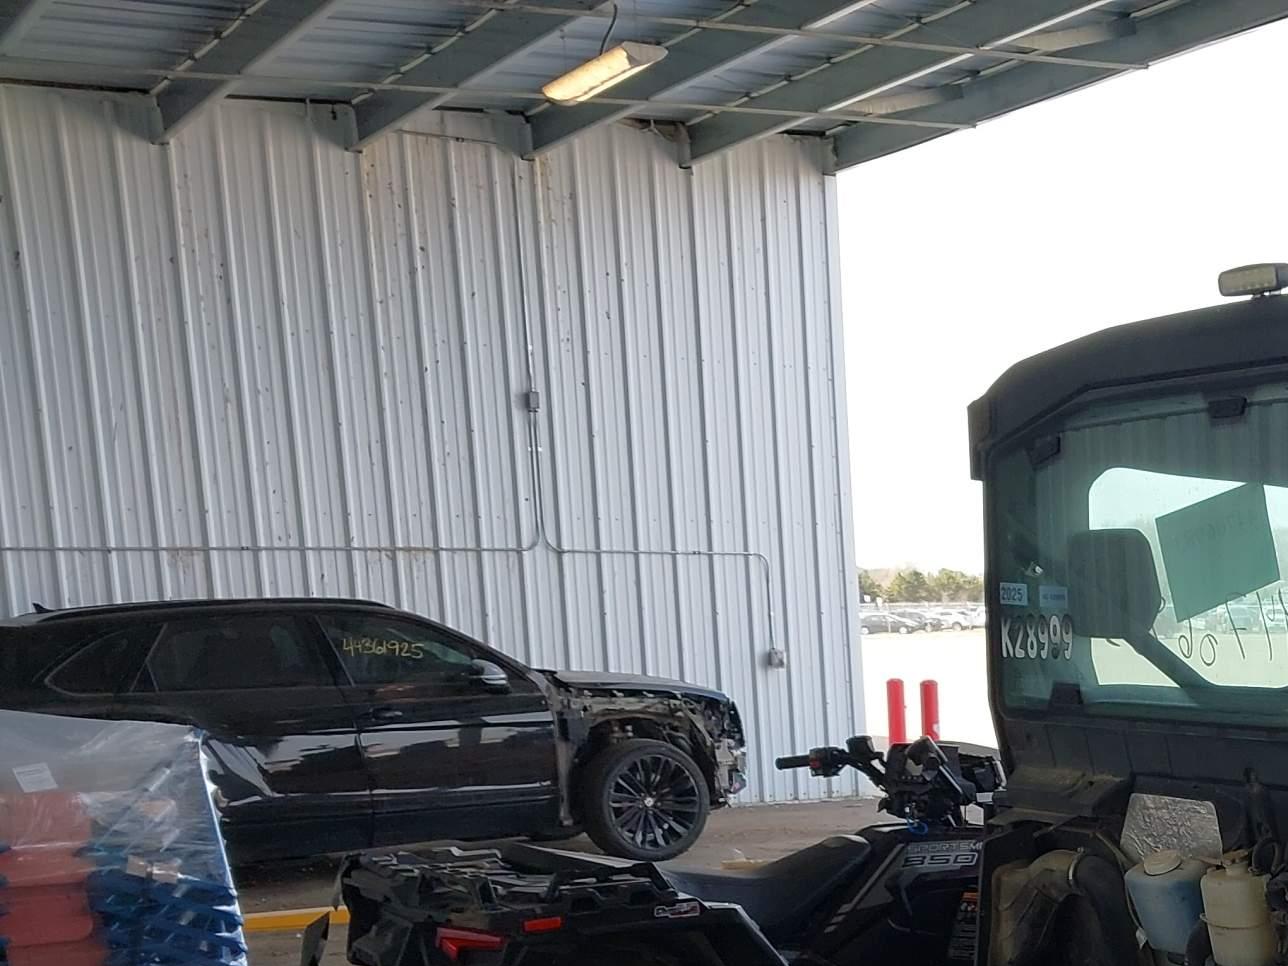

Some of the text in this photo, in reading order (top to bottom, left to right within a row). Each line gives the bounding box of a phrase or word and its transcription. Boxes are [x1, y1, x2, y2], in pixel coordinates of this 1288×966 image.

[1001, 584, 1024, 602] 2025
[1000, 614, 1073, 660] K28999
[342, 637, 425, 660] 44361925
[905, 841, 984, 854] SPORTSM
[902, 852, 979, 869] 850
